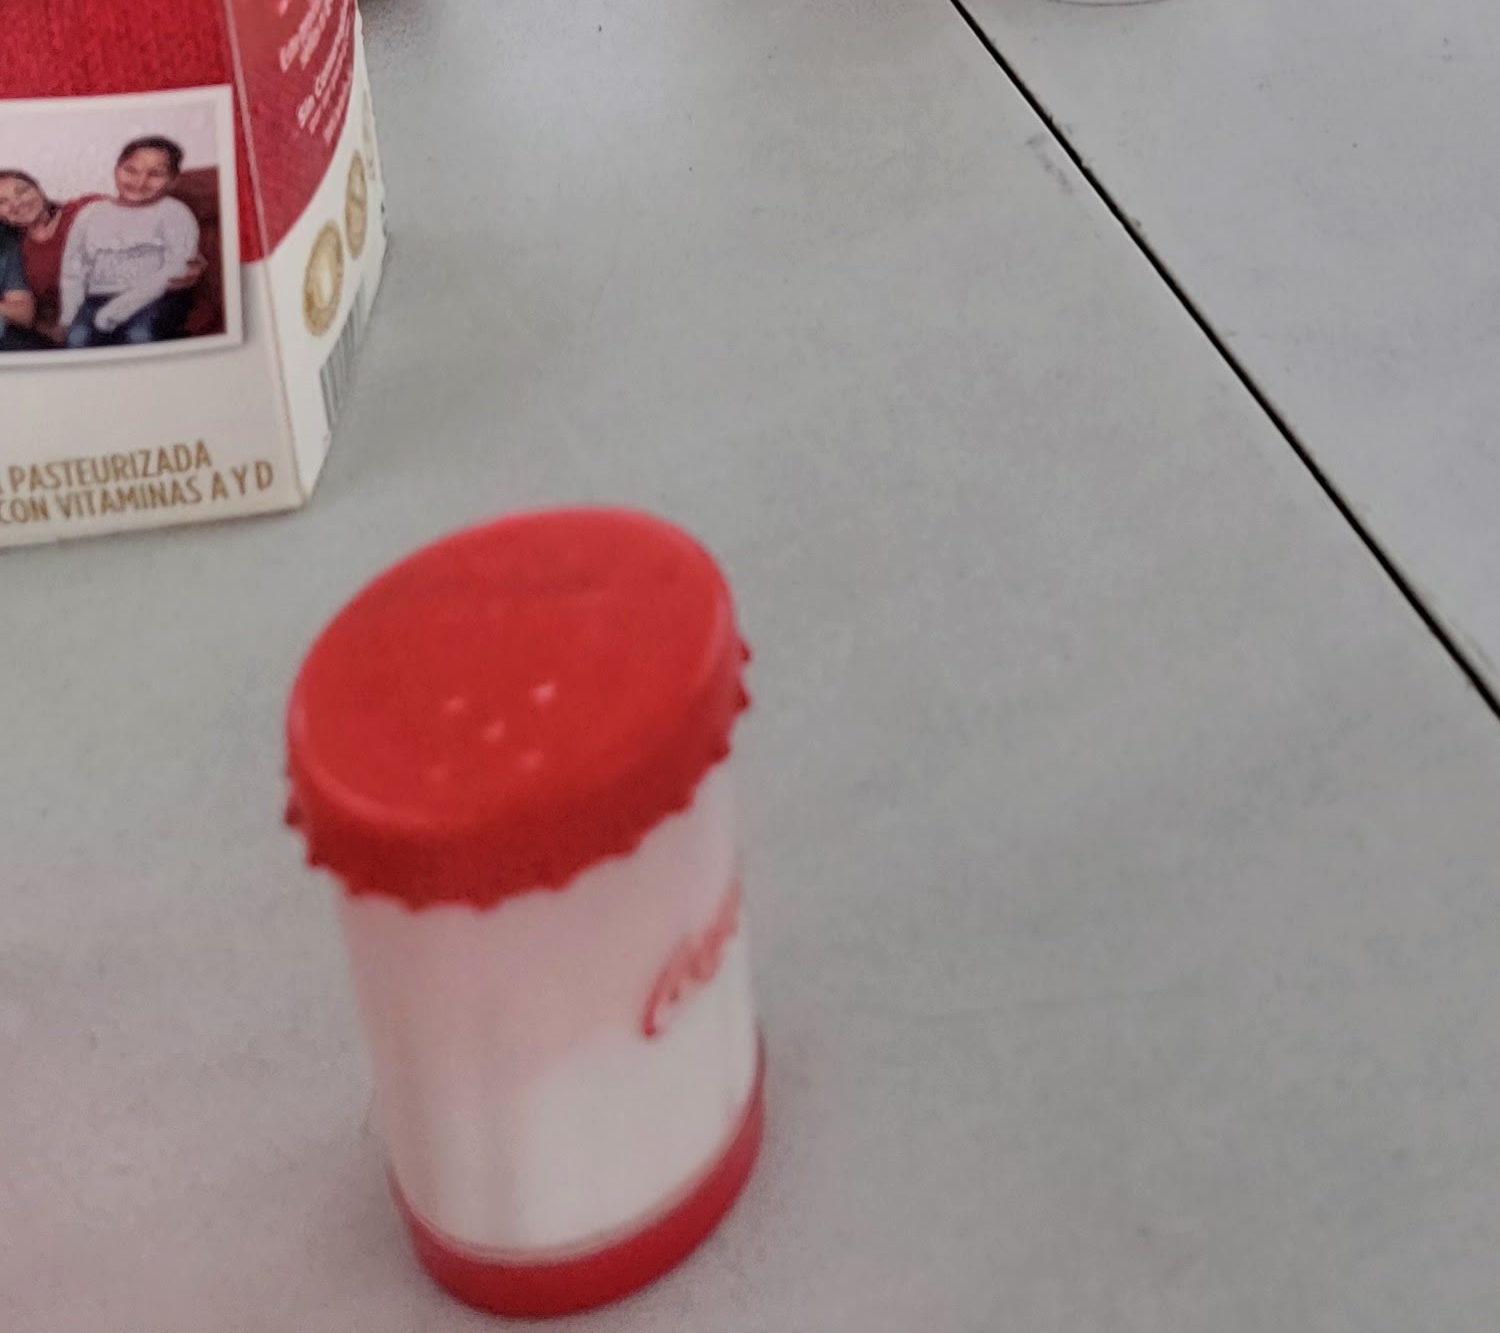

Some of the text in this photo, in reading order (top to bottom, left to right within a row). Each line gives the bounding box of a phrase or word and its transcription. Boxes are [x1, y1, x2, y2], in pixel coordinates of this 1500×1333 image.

[0, 460, 274, 525] CON VITAMINAS A Y D
[8, 439, 213, 493] PASTEURIZADA
